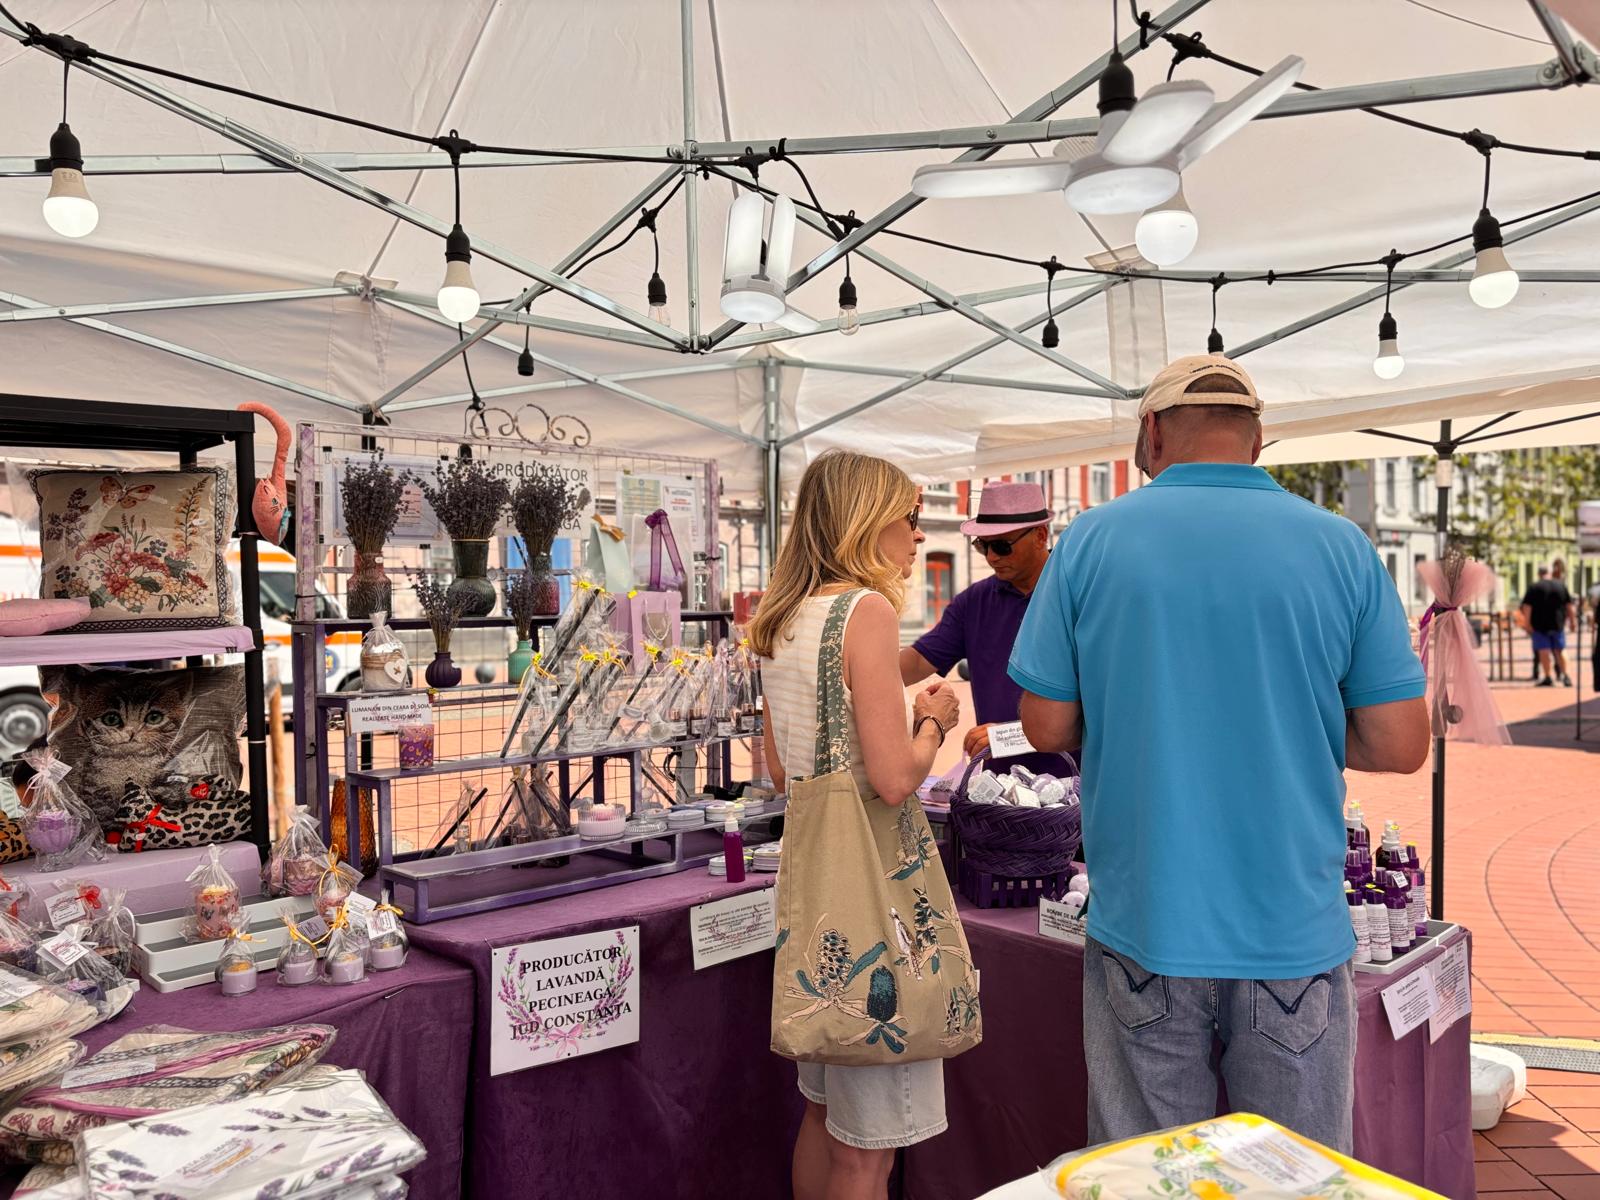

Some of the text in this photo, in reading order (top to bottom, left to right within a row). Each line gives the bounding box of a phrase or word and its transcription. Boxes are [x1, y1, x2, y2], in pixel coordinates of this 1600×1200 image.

[522, 946, 622, 974] PRODUCĂTOR
[536, 966, 605, 992] LAVANDĂ
[510, 1020, 540, 1041] JUD
